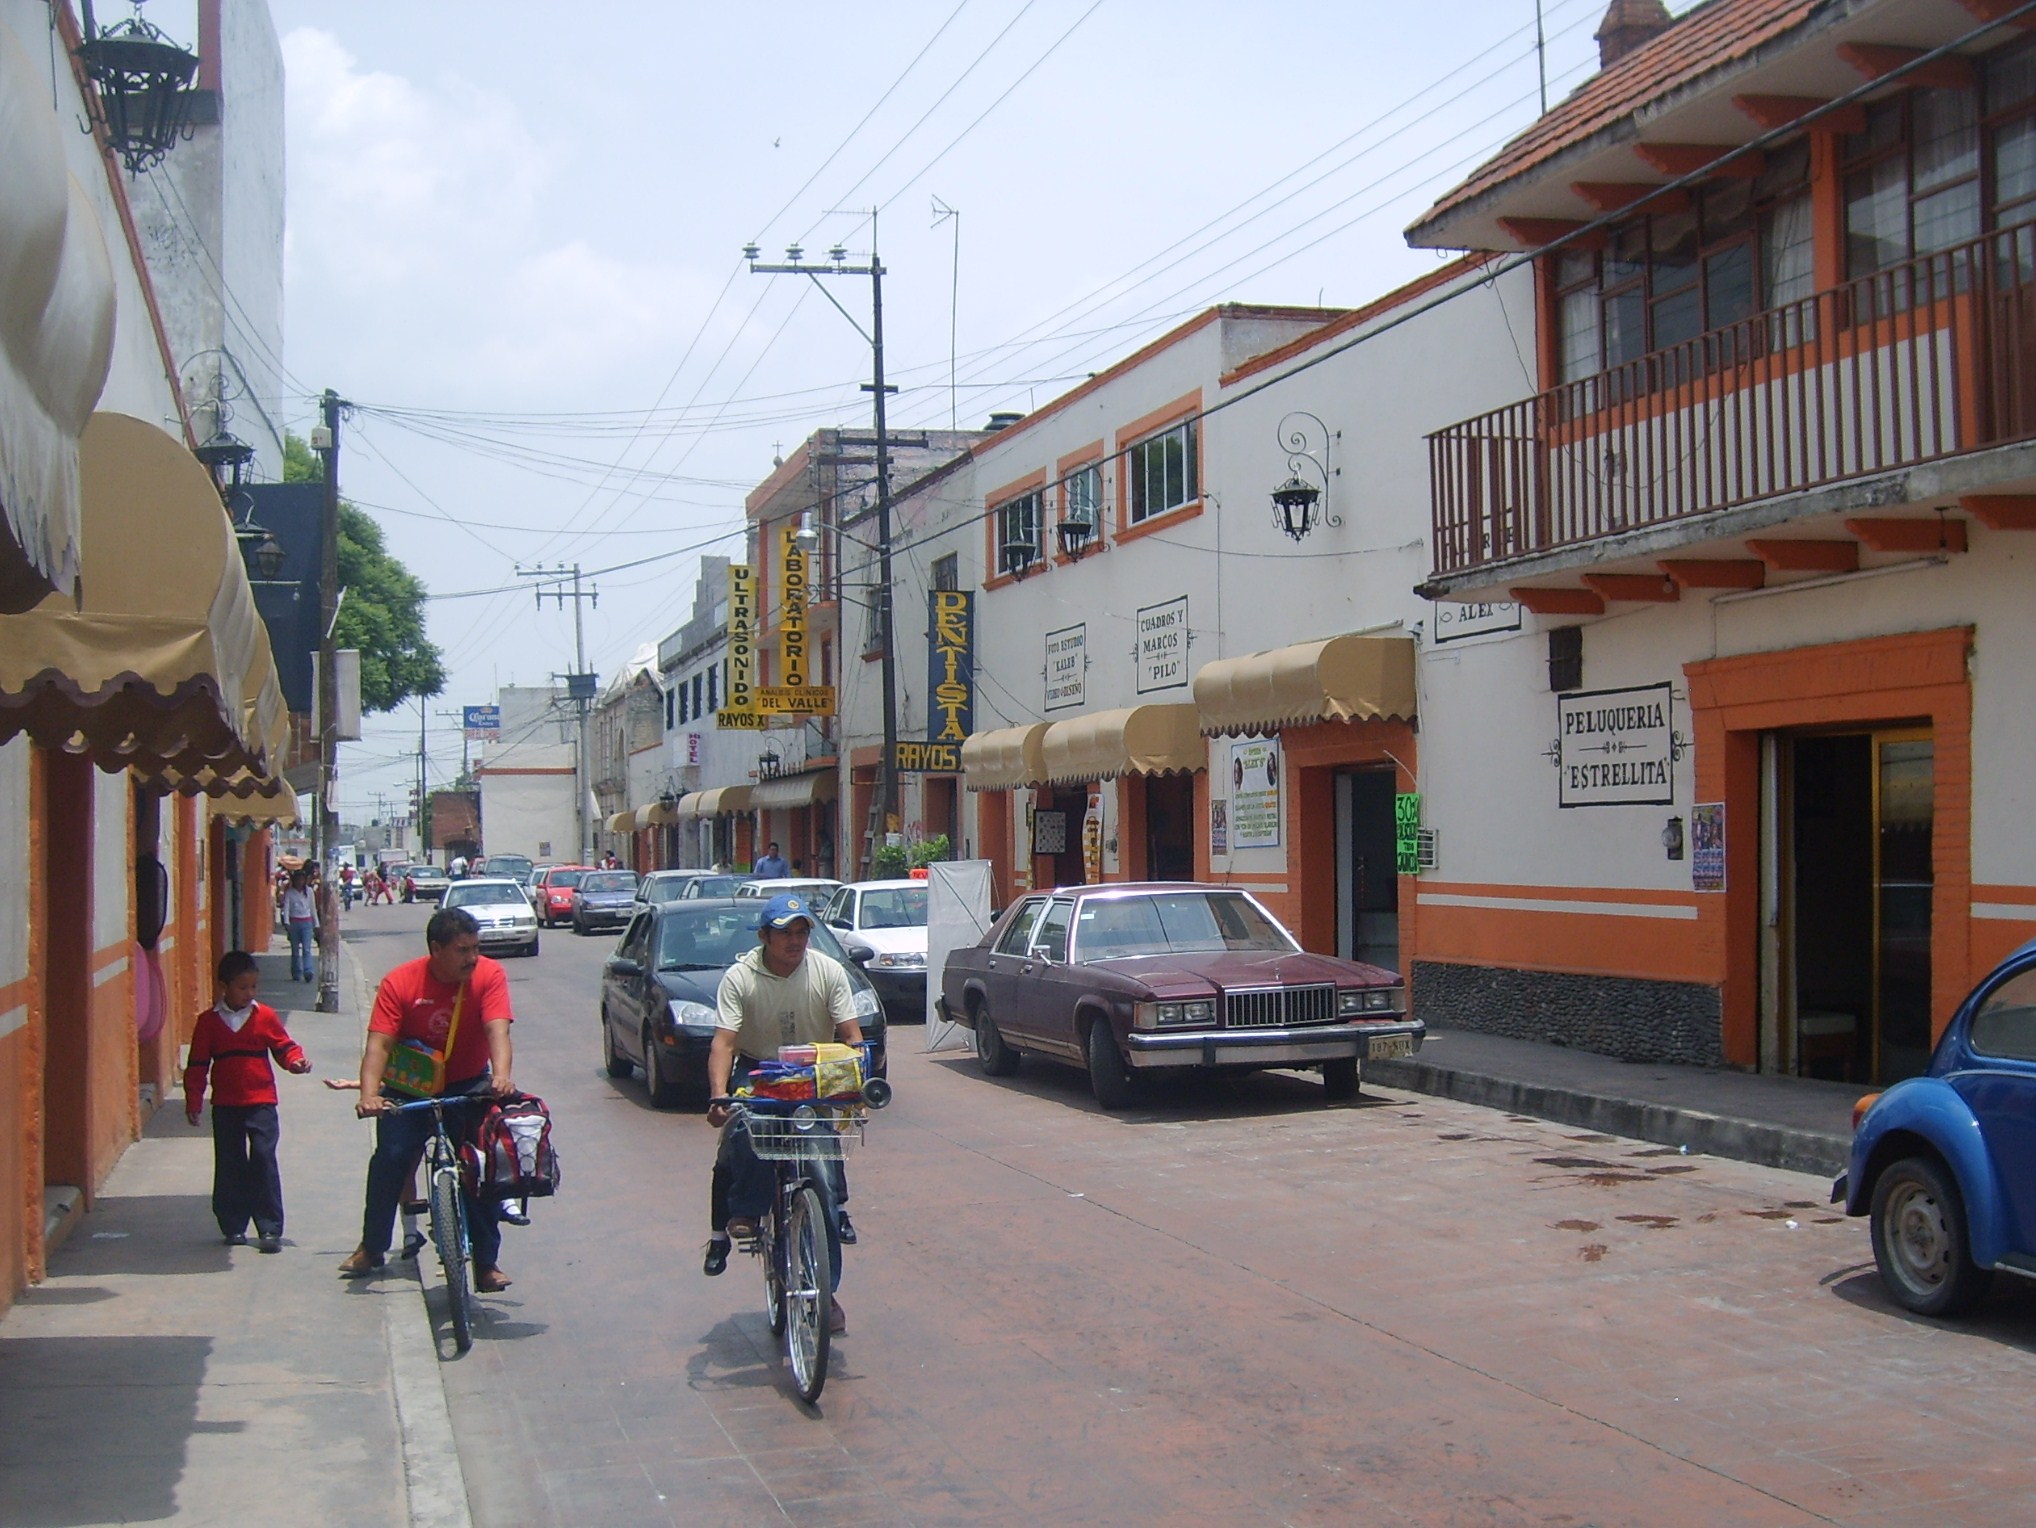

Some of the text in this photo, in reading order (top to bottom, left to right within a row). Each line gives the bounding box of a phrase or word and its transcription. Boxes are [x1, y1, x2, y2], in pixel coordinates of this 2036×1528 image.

[786, 531, 802, 686] LABORATORIO
[1141, 609, 1184, 632] CUADROS Y
[1458, 603, 1494, 622] ALEX
[734, 568, 749, 706] ULTRASONIDO
[1143, 632, 1178, 653] MARCOS
[935, 591, 968, 740] DENTISTA
[717, 713, 765, 727] RAYOS X
[1566, 702, 1665, 735] PELUQUERIA
[689, 733, 699, 763] HOTEL
[896, 743, 957, 770] RAYOS
